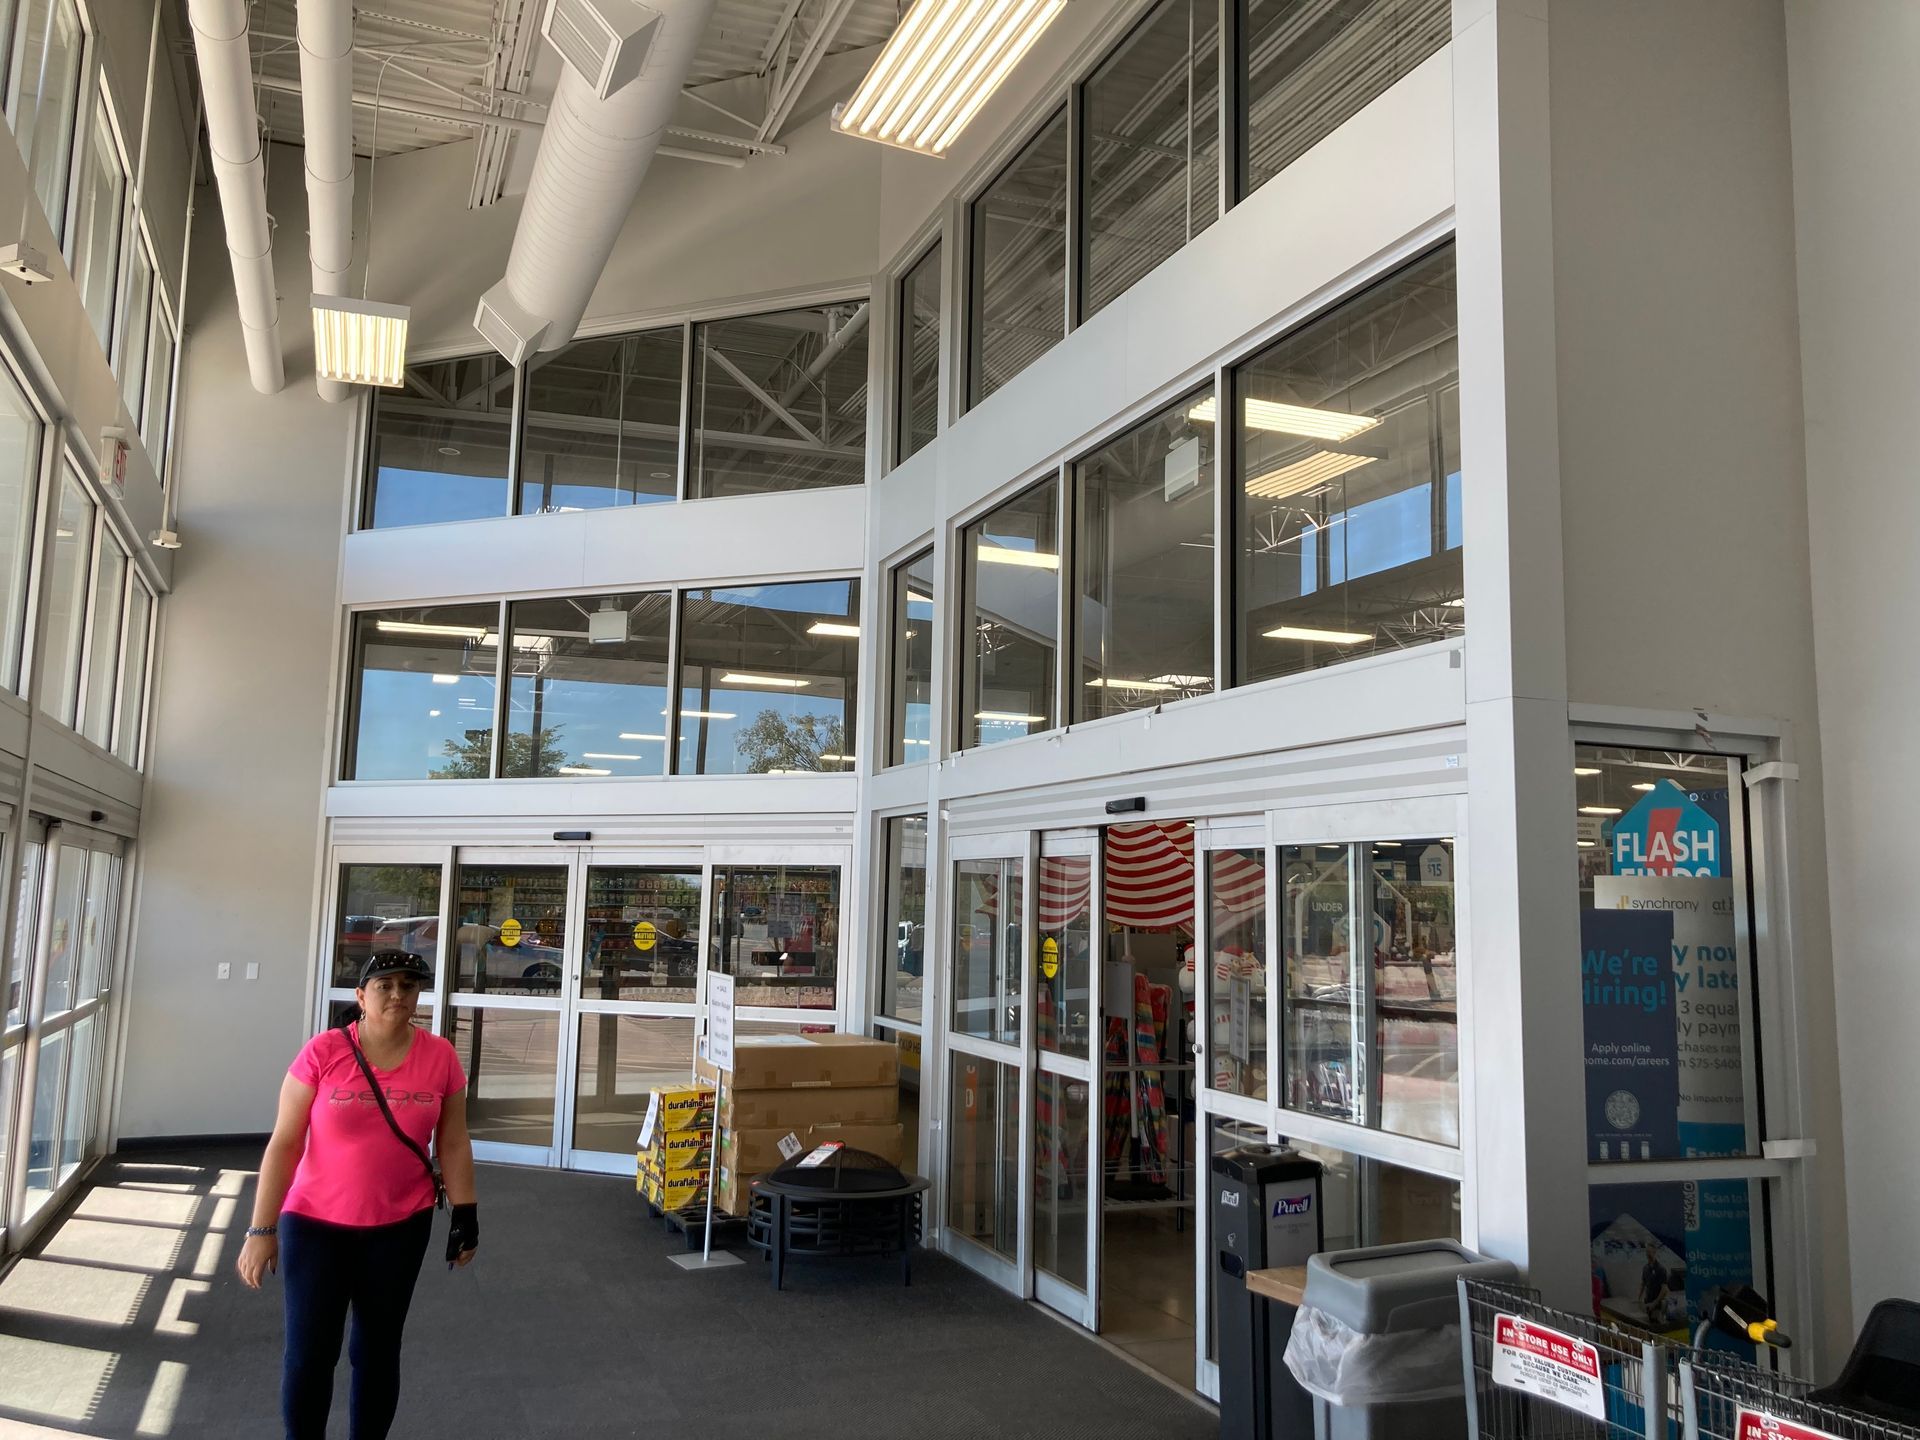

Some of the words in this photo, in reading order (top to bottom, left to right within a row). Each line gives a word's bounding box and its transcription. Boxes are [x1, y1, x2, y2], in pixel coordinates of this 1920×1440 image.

[1617, 830, 1714, 862] FLASH
[1312, 902, 1343, 913] UNDER
[1632, 897, 1699, 912] synchrony
[1582, 949, 1658, 976] We're
[1592, 1042, 1620, 1054] Apply
[1621, 1042, 1651, 1053] online
[330, 1086, 434, 1103] bebe
[668, 1098, 704, 1110] duraflame
[669, 1137, 704, 1149] duraflame
[668, 1176, 704, 1188] duraflame
[1278, 1198, 1308, 1214] Purell
[1502, 1327, 1548, 1349] IN-STORE
[1550, 1342, 1569, 1357] USE
[1571, 1351, 1593, 1367] ONLY
[1502, 1348, 1517, 1357] FOR
[1519, 1352, 1532, 1362] OUR
[1534, 1357, 1556, 1370] VALUED
[1522, 1360, 1550, 1374] BECAUSE
